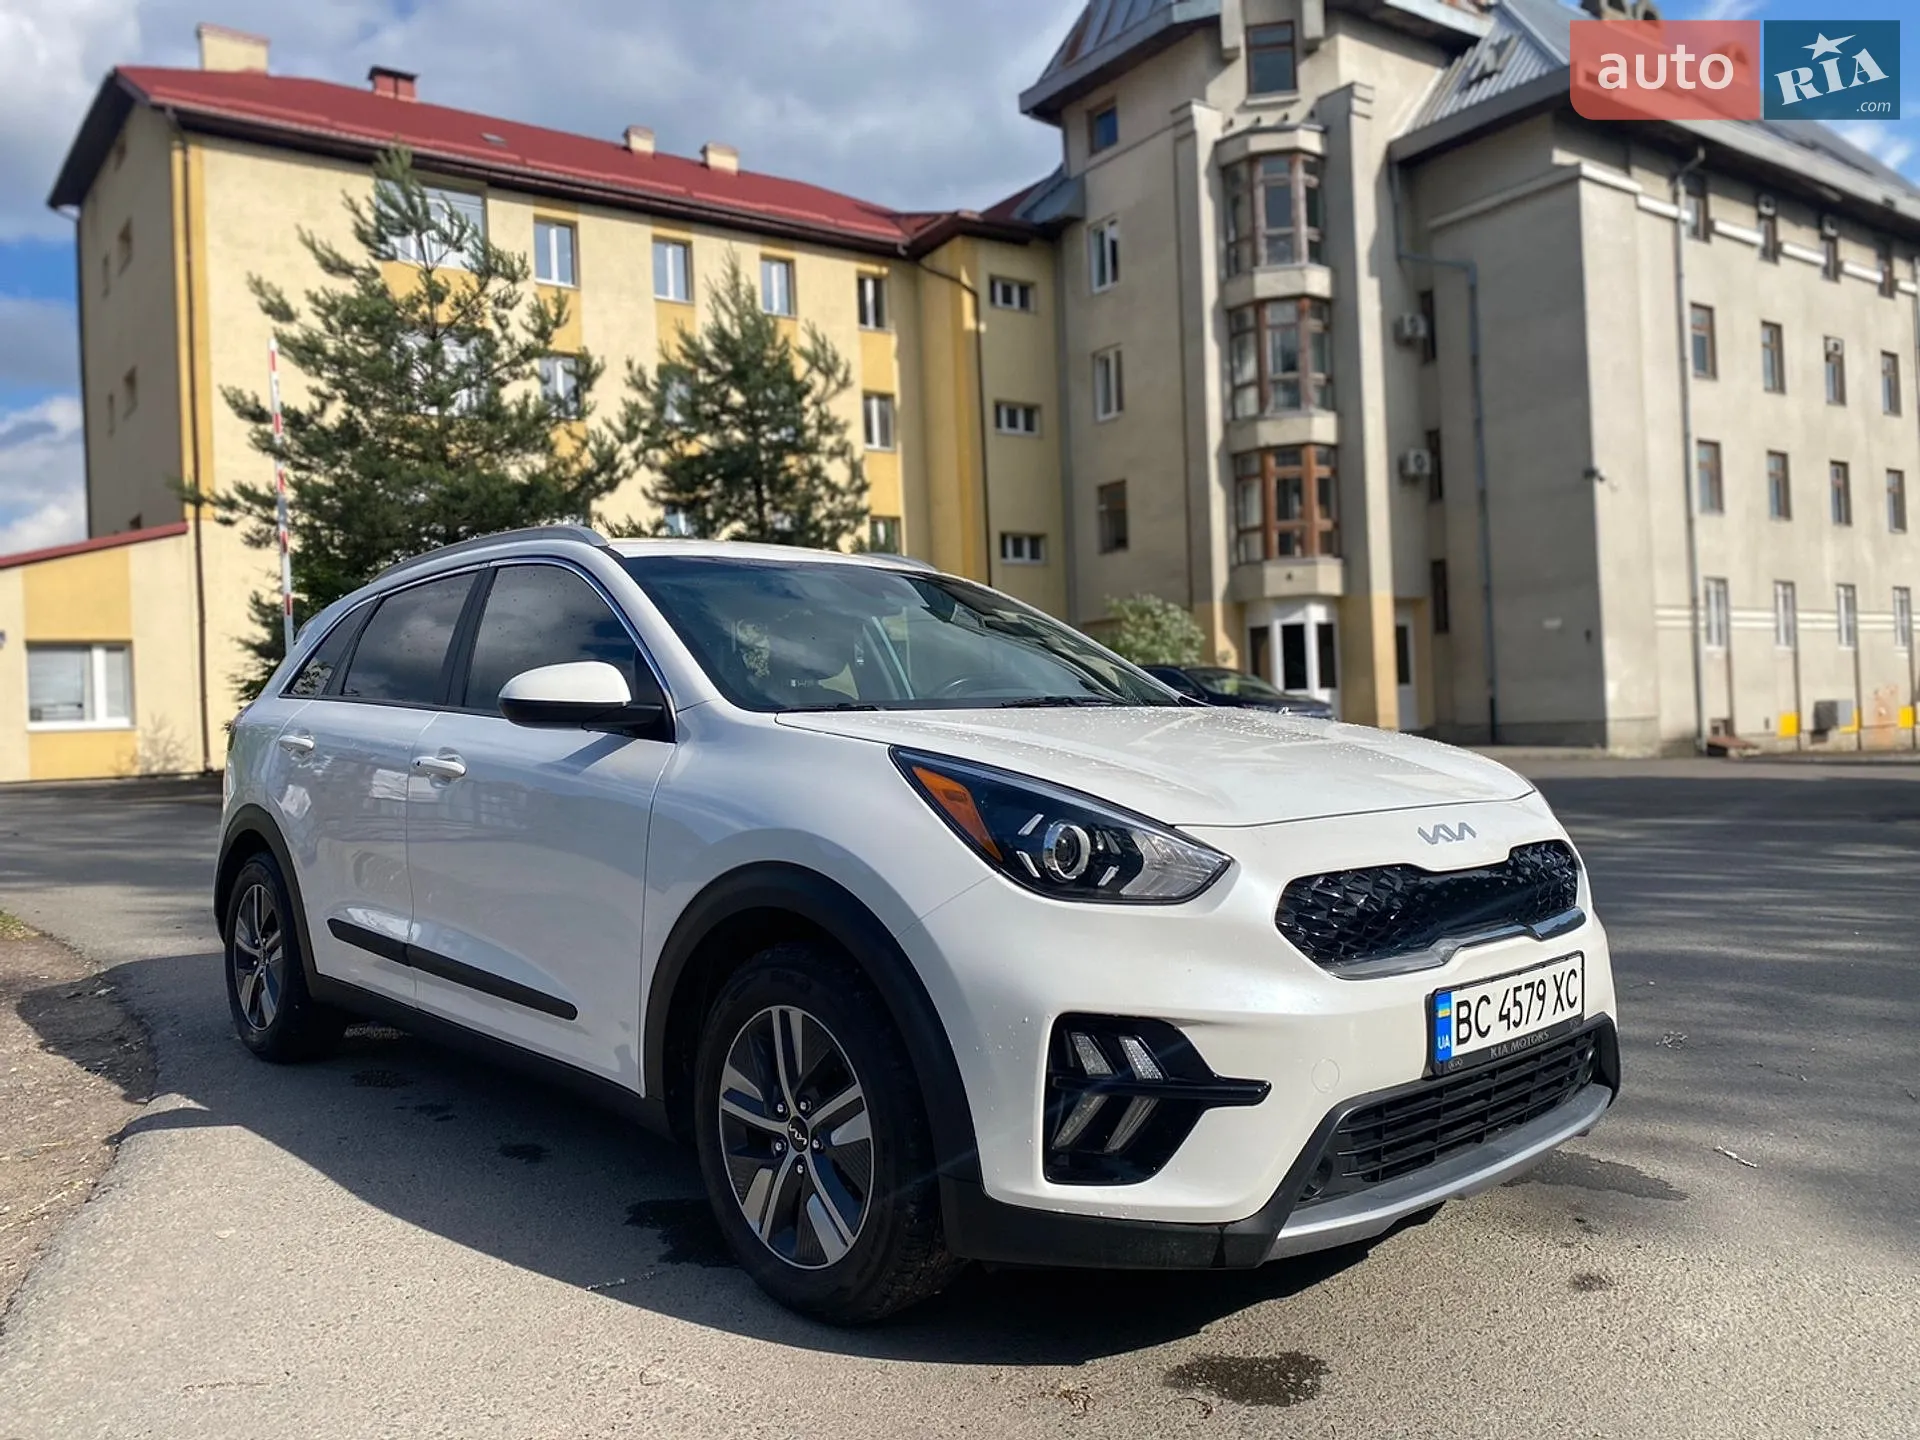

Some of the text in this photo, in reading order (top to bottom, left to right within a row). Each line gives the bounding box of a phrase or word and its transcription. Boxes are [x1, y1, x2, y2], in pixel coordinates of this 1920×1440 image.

[1456, 968, 1578, 1046] BC 4579 XC
[1437, 1034, 1450, 1050] UA
[1489, 1031, 1550, 1060] KIA MOTORS
